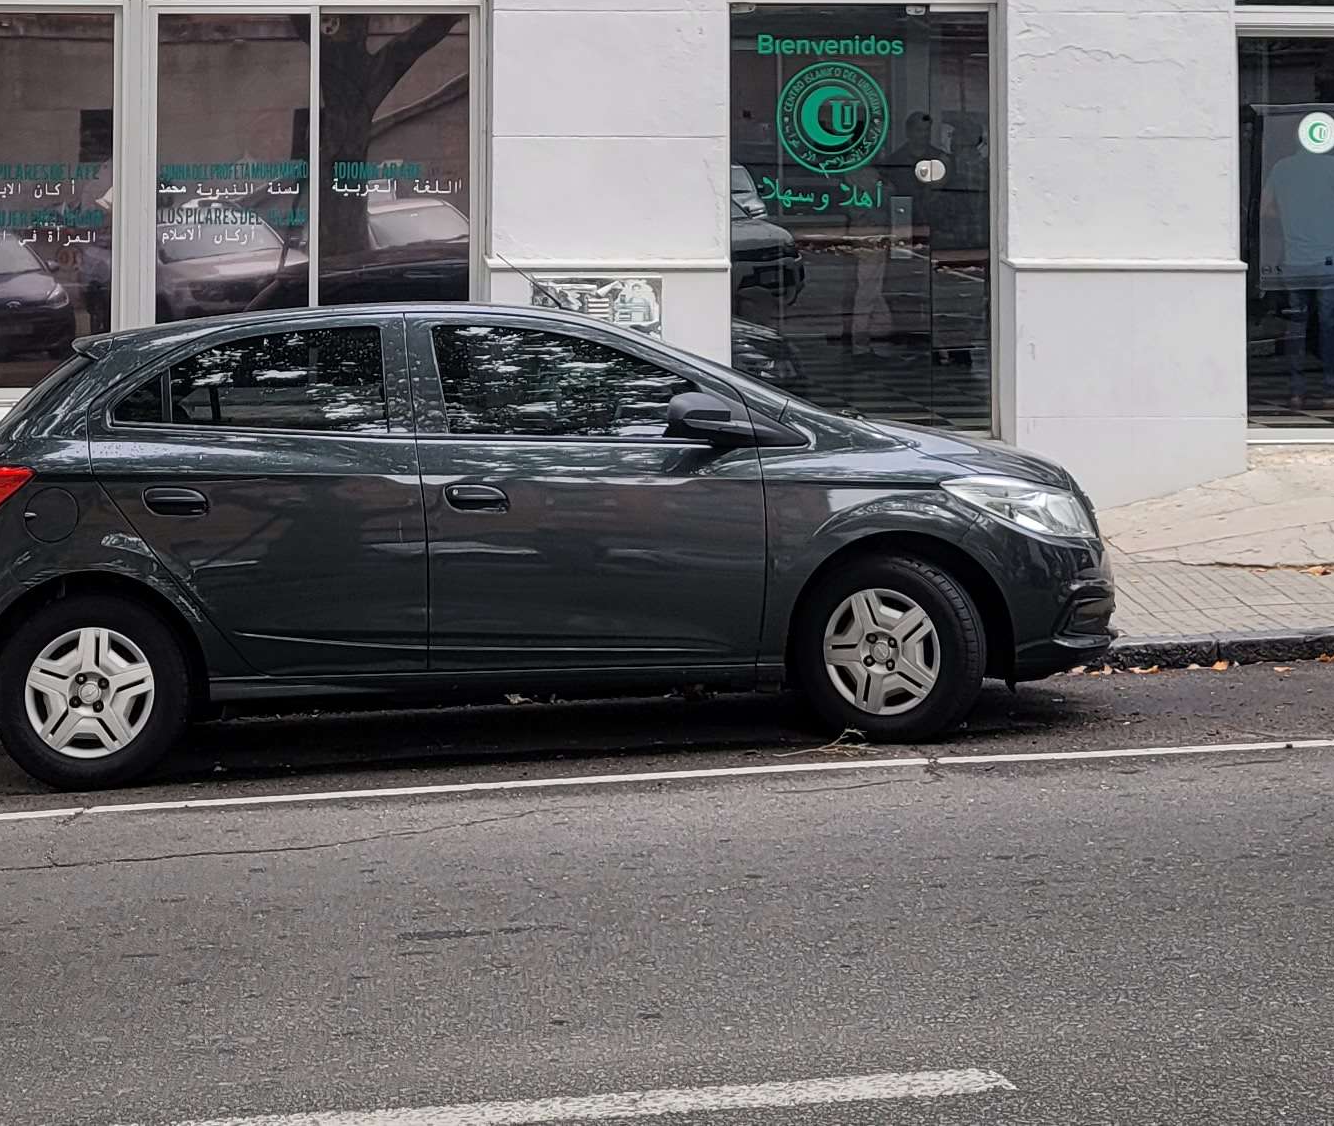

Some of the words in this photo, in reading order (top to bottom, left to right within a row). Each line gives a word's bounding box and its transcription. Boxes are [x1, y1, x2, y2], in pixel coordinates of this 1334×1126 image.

[757, 35, 904, 55] Bienvenidos
[784, 79, 805, 113] CENTRO
[842, 69, 857, 84] DEL
[158, 182, 187, 193] محمد
[331, 178, 397, 196] العربية
[160, 208, 183, 225] LOS
[185, 208, 237, 225] PILARES
[238, 208, 262, 225] DEL
